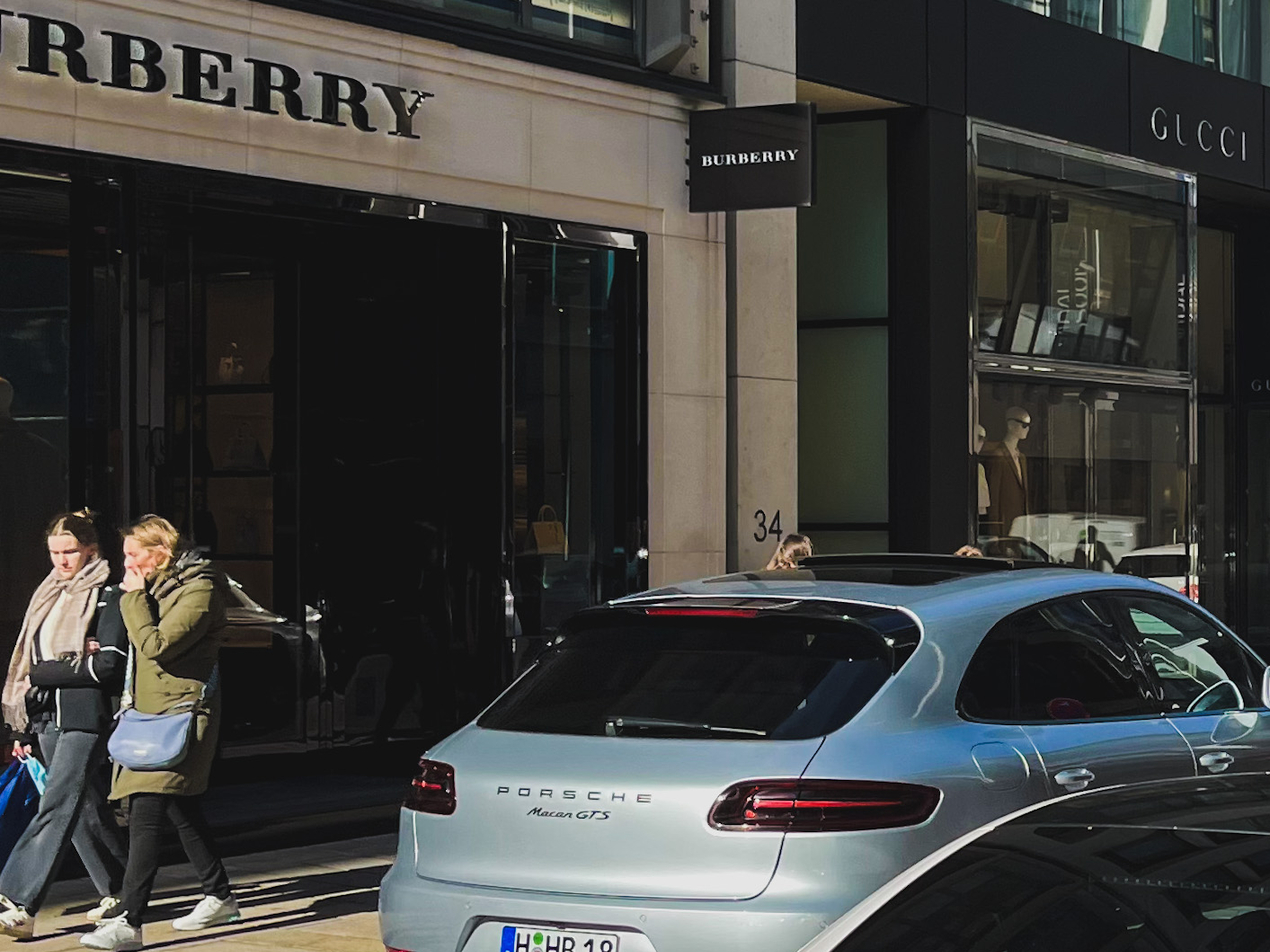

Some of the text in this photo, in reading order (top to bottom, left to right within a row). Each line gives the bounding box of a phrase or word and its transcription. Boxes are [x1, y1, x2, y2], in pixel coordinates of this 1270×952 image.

[0, 10, 435, 139] RBERRY
[1151, 106, 1246, 161] GUCCI
[702, 149, 799, 167] BURBERRY
[753, 509, 783, 542] 34
[497, 786, 652, 803] PORSCHE
[526, 807, 612, 821] Macan GTS
